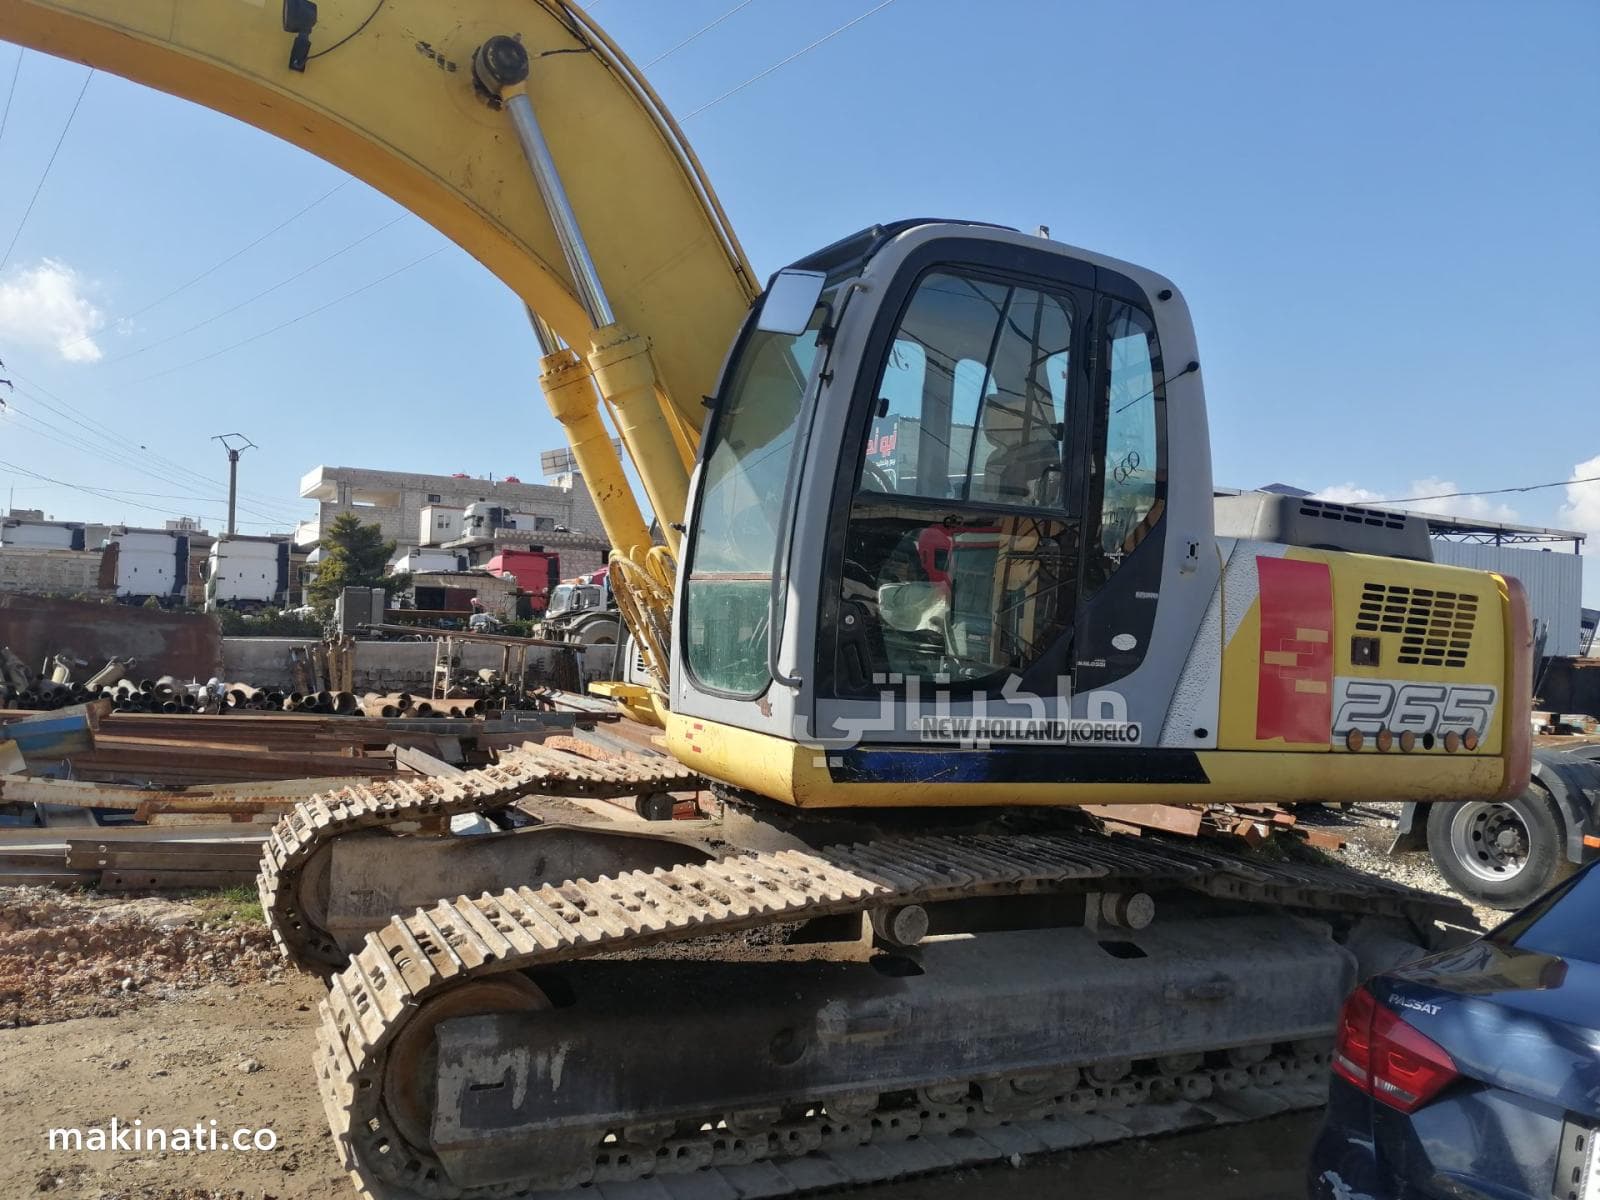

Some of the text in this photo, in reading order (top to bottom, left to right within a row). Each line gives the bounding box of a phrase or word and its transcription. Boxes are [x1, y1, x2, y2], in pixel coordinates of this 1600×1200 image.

[1333, 681, 1495, 738] 265
[922, 717, 1141, 743] NEW HOLLAND KOBELCO
[1388, 993, 1442, 1016] PASSAT
